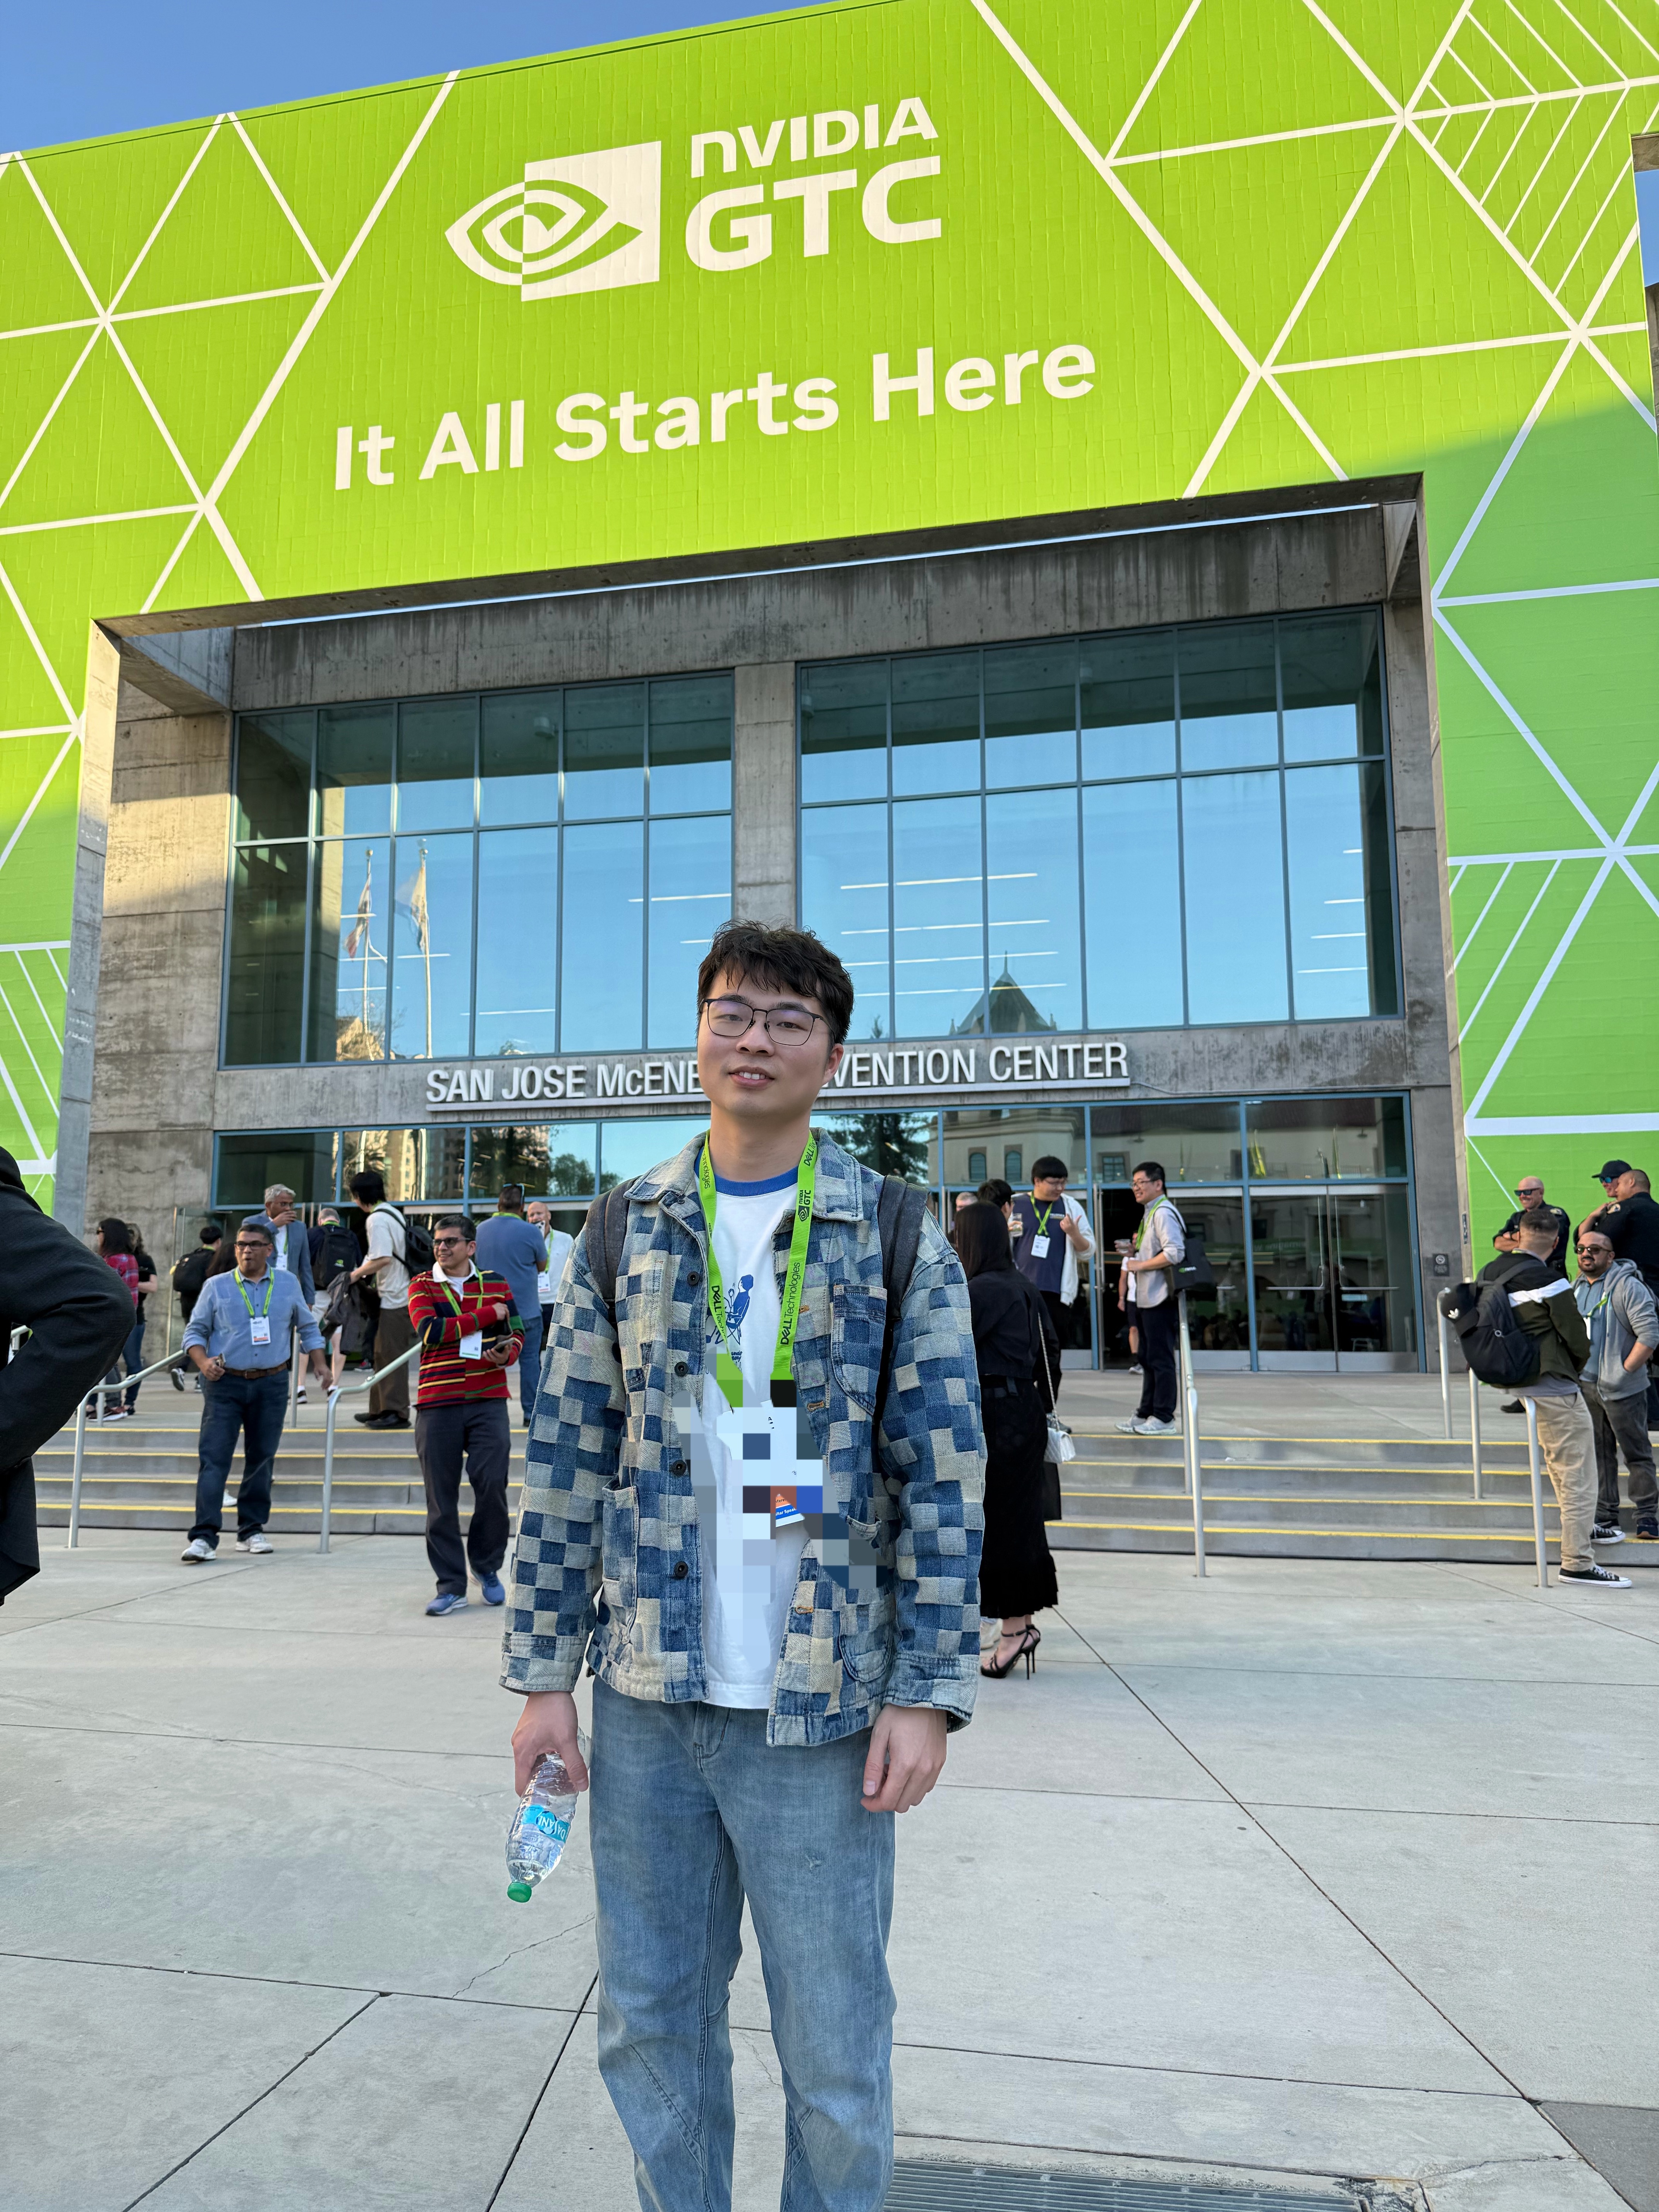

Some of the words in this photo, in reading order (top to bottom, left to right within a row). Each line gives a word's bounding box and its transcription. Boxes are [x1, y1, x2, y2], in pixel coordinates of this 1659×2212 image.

[686, 156, 941, 271] GTC
[336, 426, 395, 490] It
[419, 400, 524, 480] All
[554, 372, 839, 461] Starts
[873, 345, 1095, 421] Here
[426, 1068, 494, 1103] SAN
[502, 1065, 587, 1100] JOSE
[597, 1060, 704, 1097] McENE
[821, 1048, 975, 1087] VENTION
[989, 1042, 1128, 1081] CENTER
[784, 1262, 801, 1318] Technologies
